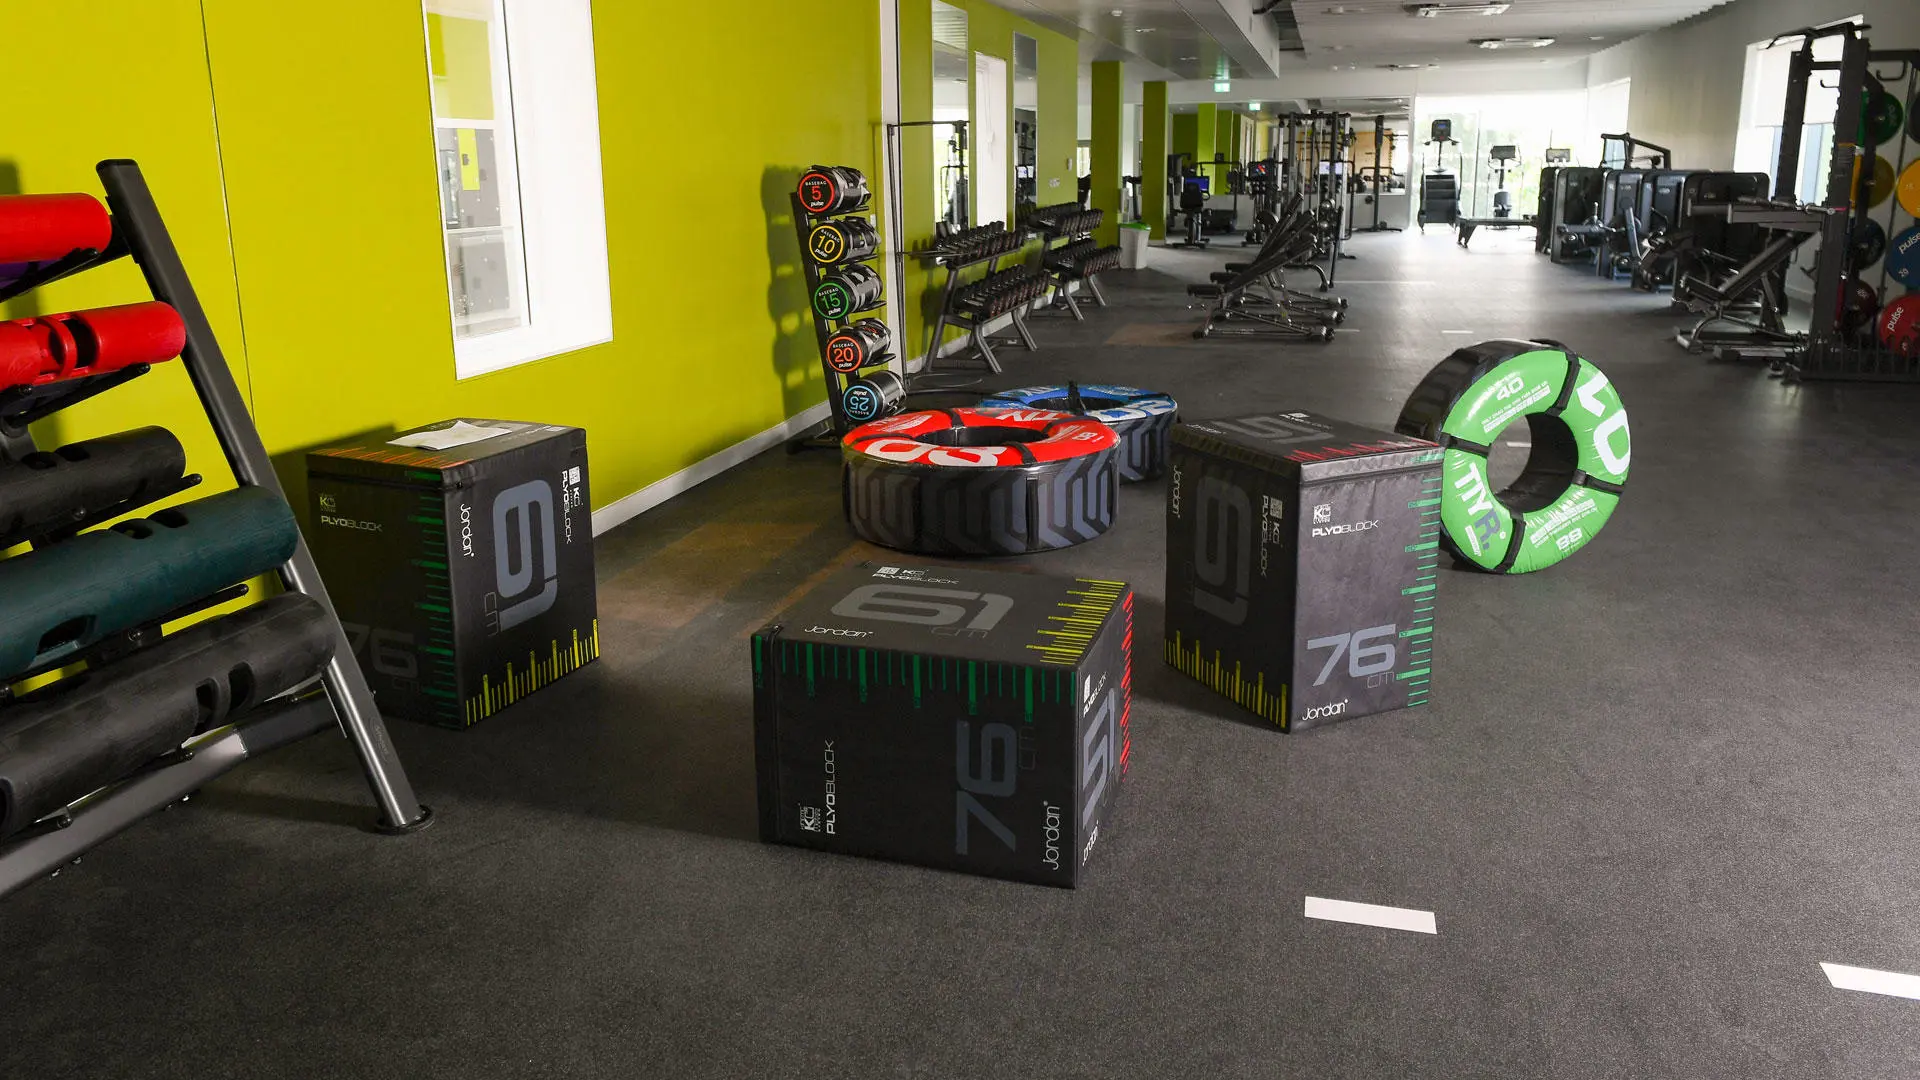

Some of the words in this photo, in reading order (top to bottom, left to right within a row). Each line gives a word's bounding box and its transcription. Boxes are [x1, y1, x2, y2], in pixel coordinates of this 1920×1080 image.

[811, 185, 823, 201] 5
[817, 235, 836, 254] 10
[821, 293, 841, 309] 15
[1886, 306, 1905, 332] pulse
[833, 347, 854, 363] 20
[1496, 376, 1525, 401] 40
[849, 396, 870, 411] 25
[1173, 464, 1181, 519] Jordan
[561, 469, 573, 544] PLYOBLOCK
[320, 515, 384, 533] PLYOBLOCK
[459, 503, 475, 558] Jordan
[1261, 495, 1273, 577] PLYOBLOCK
[1312, 519, 1379, 538] PLYOBLOCK
[492, 478, 558, 633] 61
[872, 573, 960, 585] PLYOBLOCK
[830, 583, 1015, 631] 61
[804, 625, 873, 638] Jordan
[1307, 623, 1396, 687] 76
[1302, 699, 1348, 721] Jordan
[1083, 687, 1115, 831] 51
[826, 739, 836, 835] PLYOBLOCK
[956, 720, 1017, 855] 76
[1042, 801, 1061, 871] Jordan
